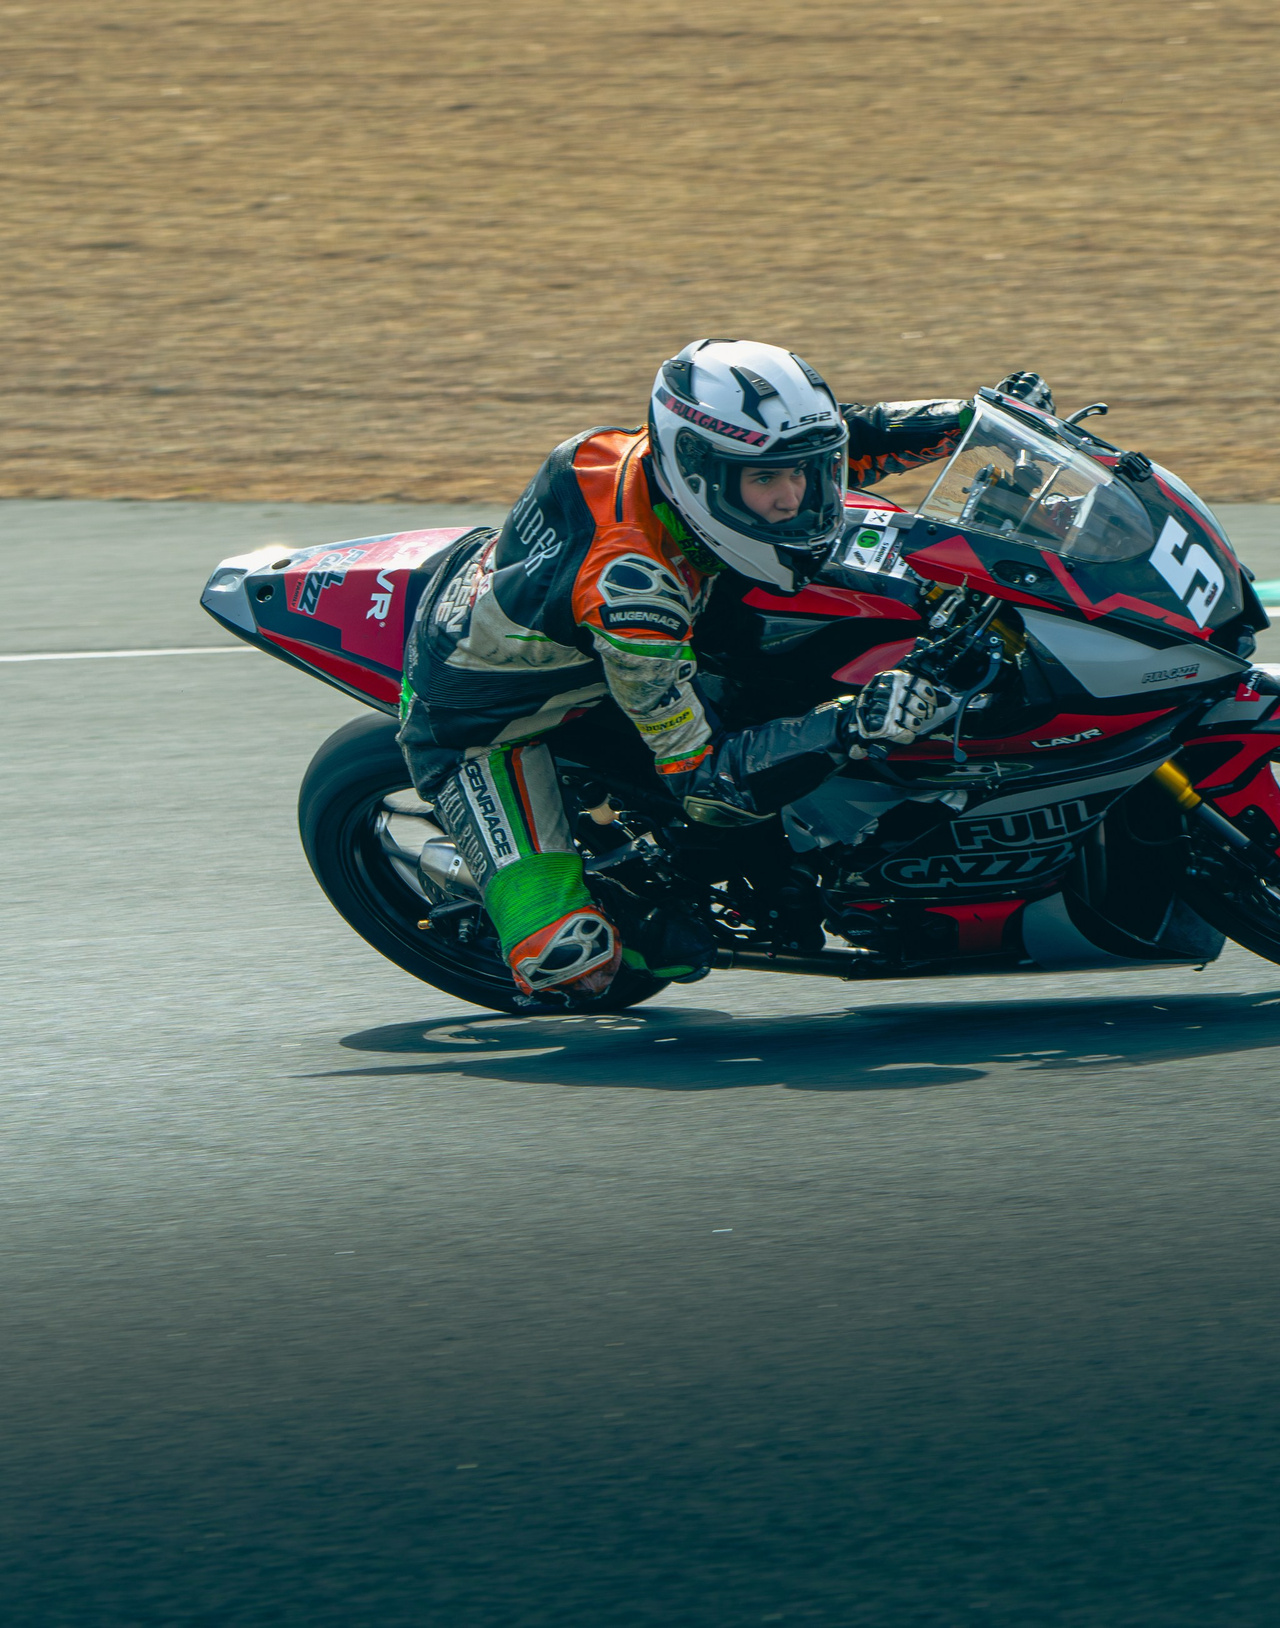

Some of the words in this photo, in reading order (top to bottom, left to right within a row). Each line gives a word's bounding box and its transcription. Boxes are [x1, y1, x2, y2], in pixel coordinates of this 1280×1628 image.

[780, 411, 832, 432] LS2
[1148, 515, 1225, 629] 5
[609, 611, 681, 631] MUGENRACE
[645, 711, 690, 732] DUNLOP
[1030, 728, 1103, 748] LAVR
[951, 800, 1091, 850] FULL
[881, 842, 1076, 888] GAZZZ
